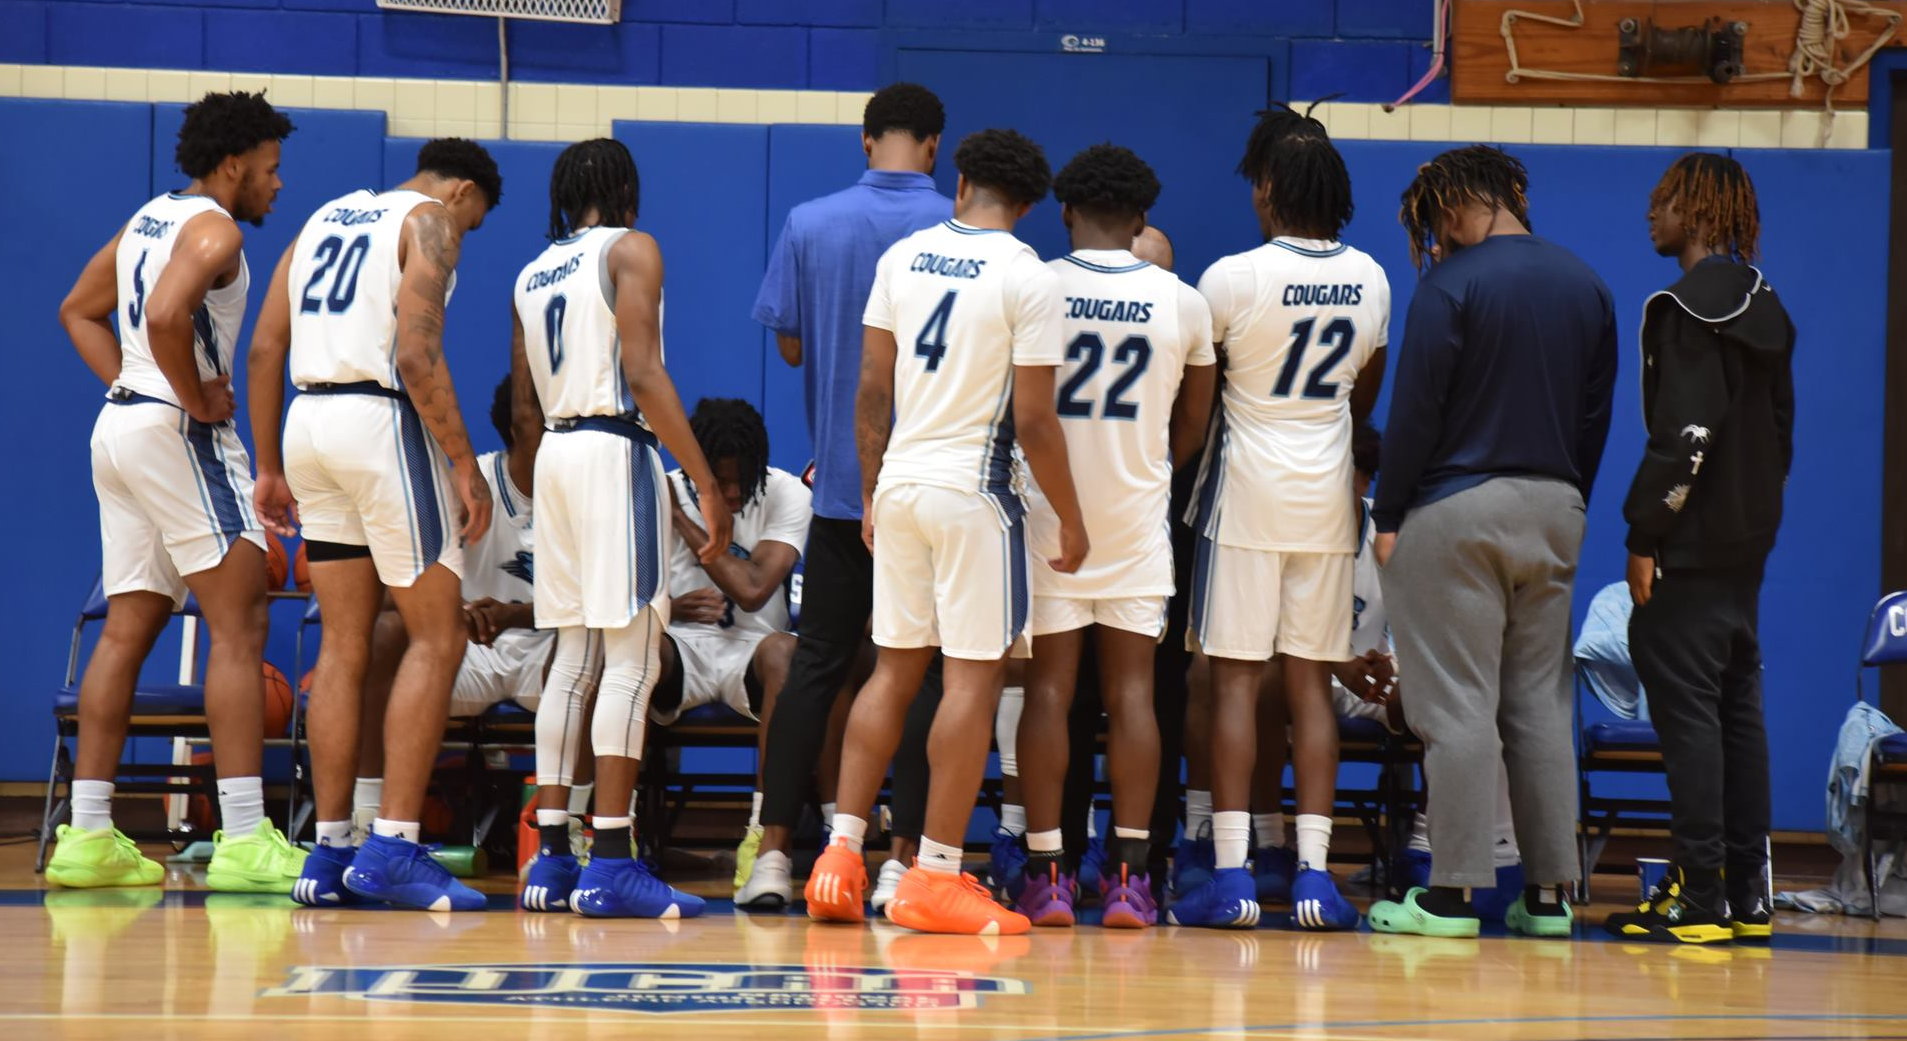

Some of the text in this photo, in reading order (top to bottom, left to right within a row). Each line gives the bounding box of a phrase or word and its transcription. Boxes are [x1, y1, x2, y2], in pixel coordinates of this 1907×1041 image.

[300, 233, 371, 316] 20
[911, 252, 987, 279] COUGARS
[1282, 284, 1363, 306] COUGARS
[544, 292, 567, 377] 0
[914, 288, 960, 373] 4
[1270, 316, 1357, 400] 12
[1056, 330, 1154, 421] 22
